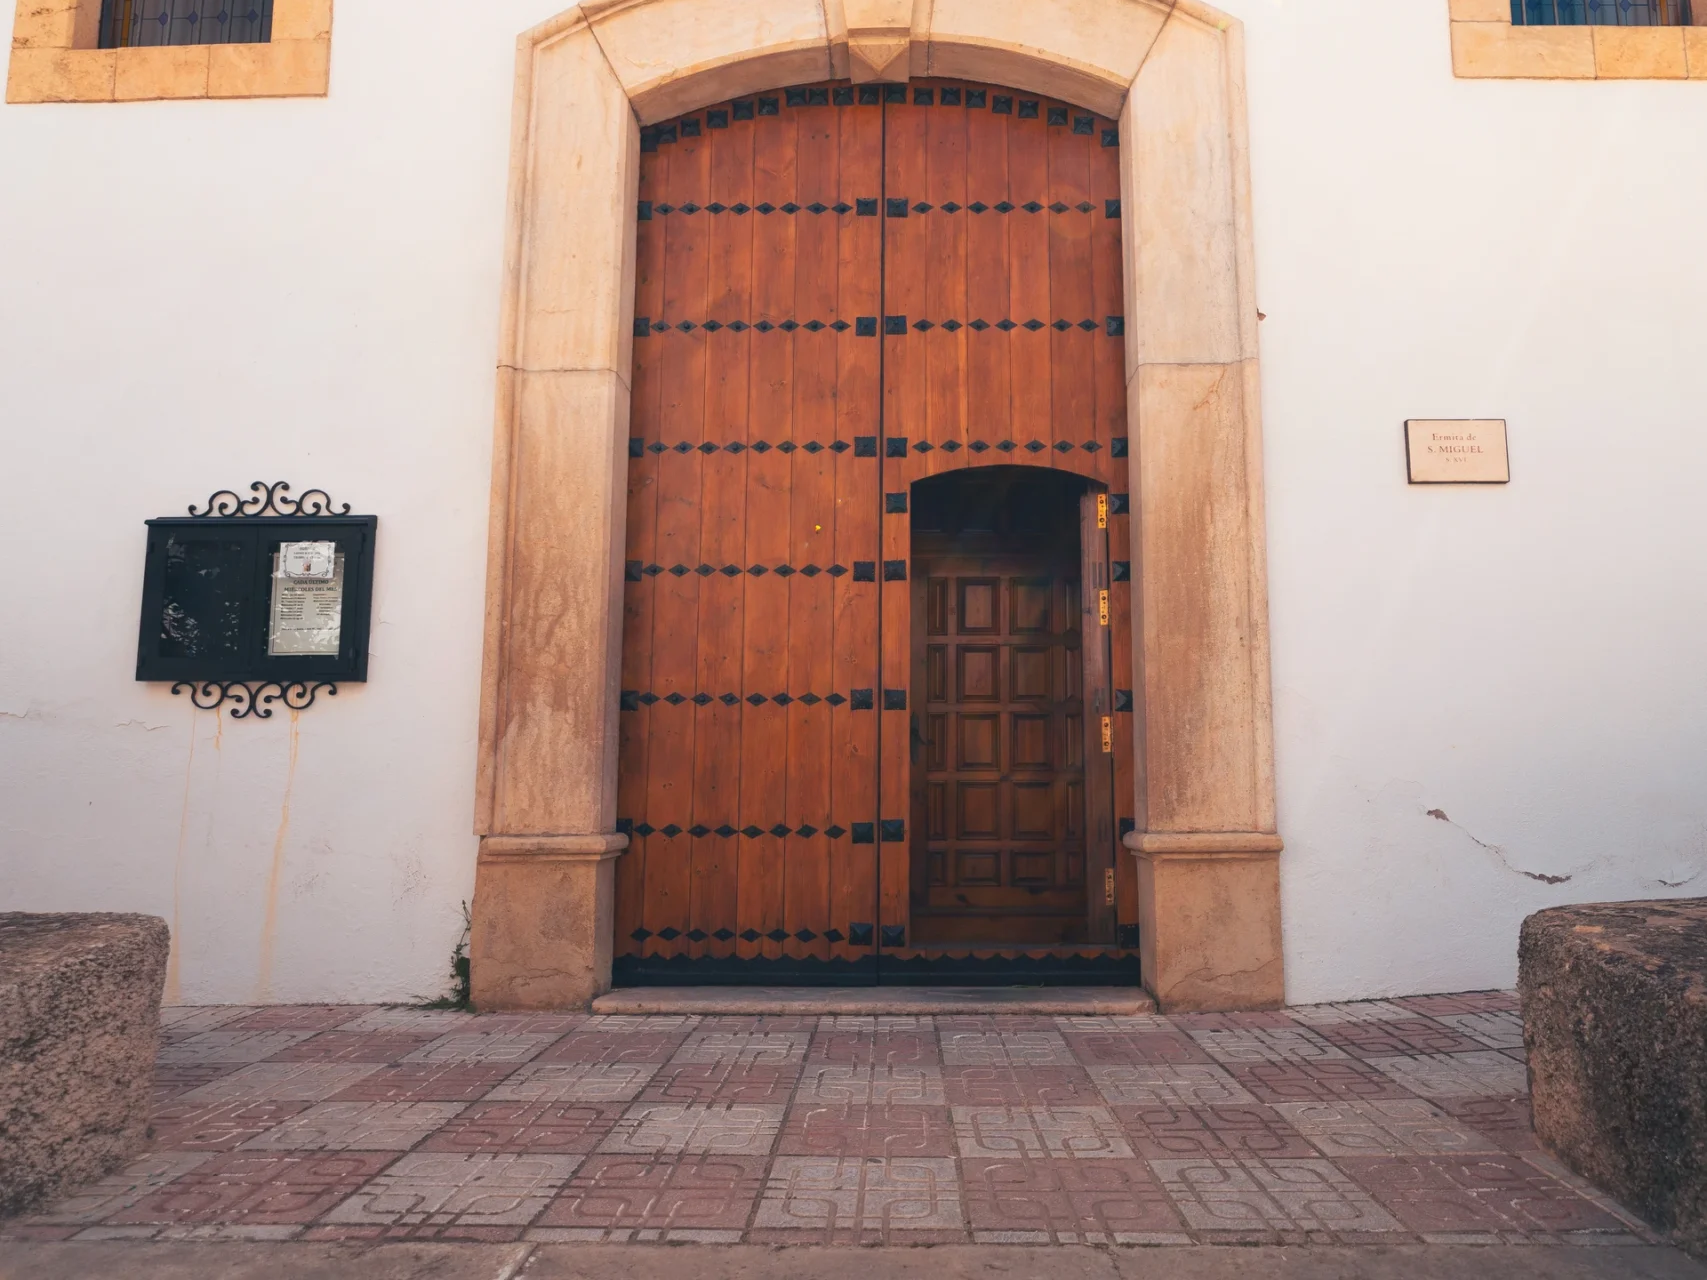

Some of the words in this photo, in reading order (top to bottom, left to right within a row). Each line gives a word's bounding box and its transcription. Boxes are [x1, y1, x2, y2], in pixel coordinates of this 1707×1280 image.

[1432, 433, 1464, 441] Ermita
[1466, 433, 1477, 441] de
[1427, 445, 1436, 453] S.
[1439, 445, 1484, 453] MIGUEL
